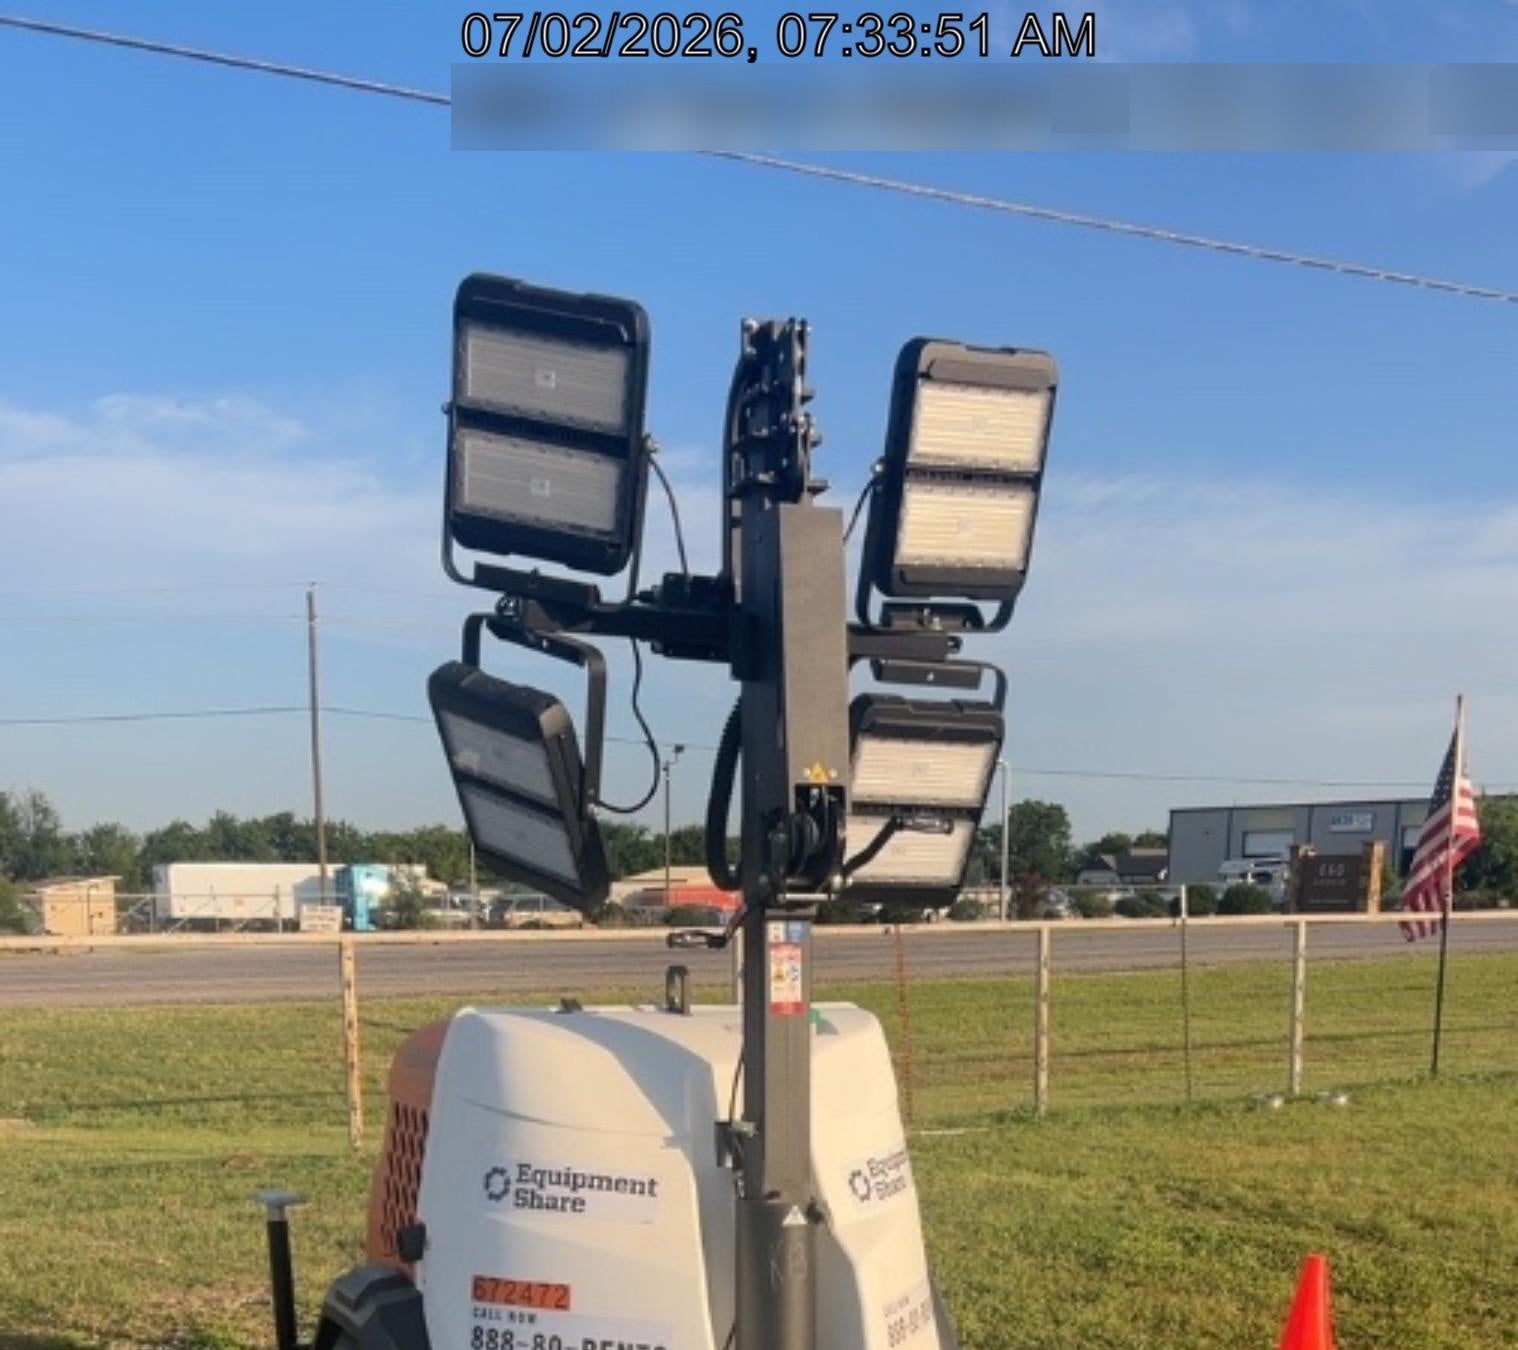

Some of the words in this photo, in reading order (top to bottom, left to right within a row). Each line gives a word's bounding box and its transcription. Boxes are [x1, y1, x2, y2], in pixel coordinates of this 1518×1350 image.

[516, 1163, 659, 1197] Equipment
[513, 1188, 586, 1213] Share
[472, 1276, 569, 1310] 672472
[473, 1307, 502, 1321] CALL
